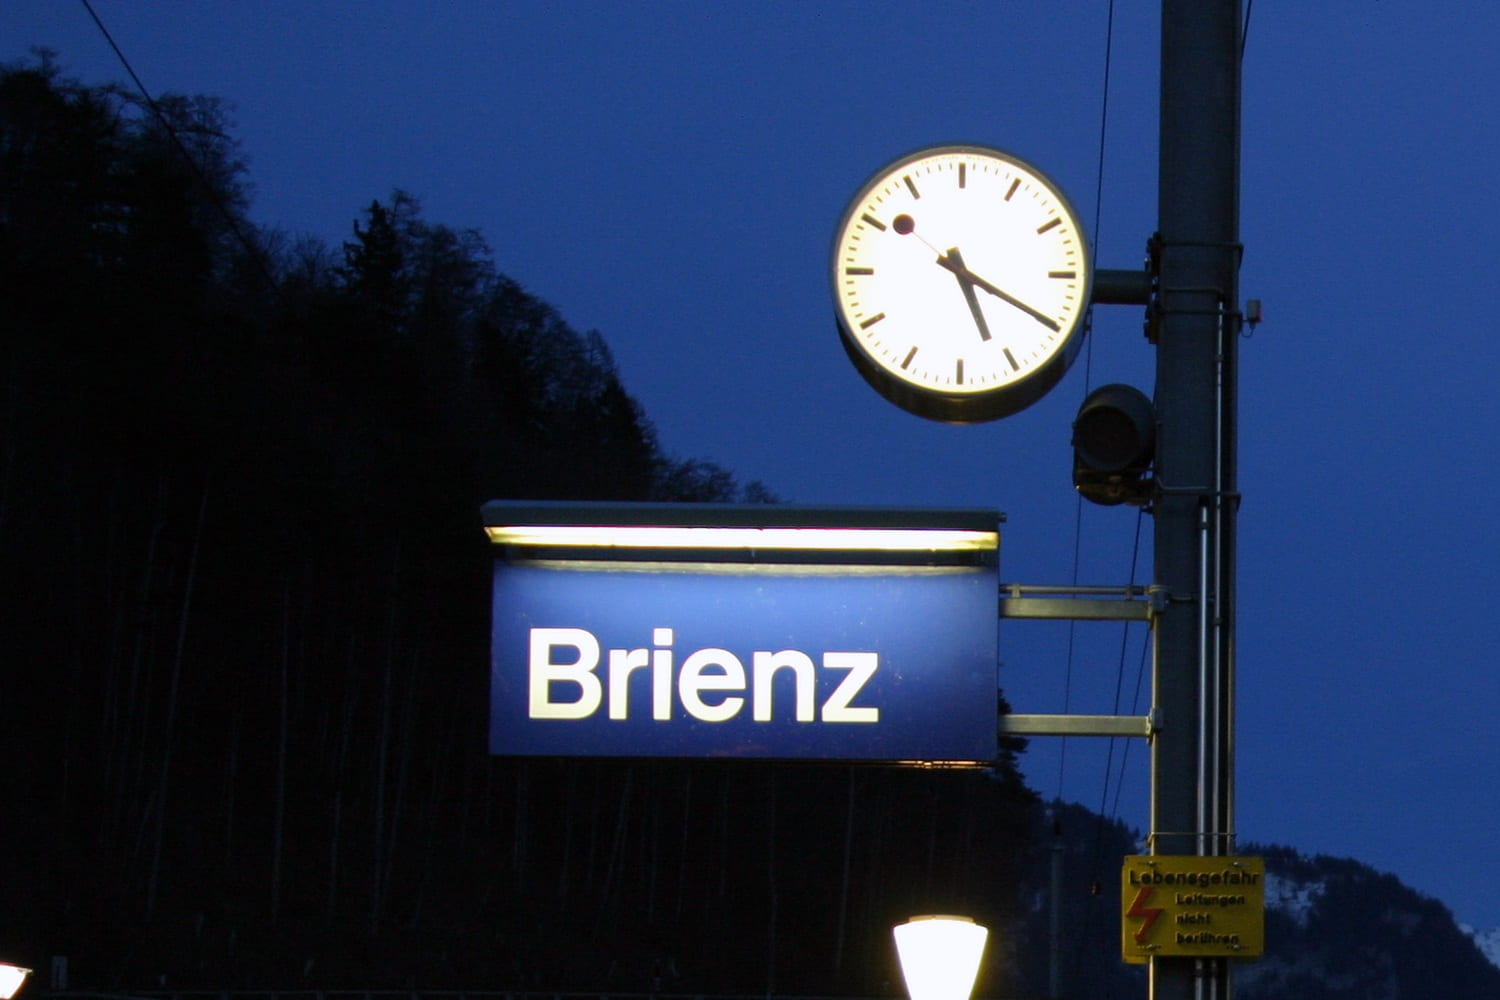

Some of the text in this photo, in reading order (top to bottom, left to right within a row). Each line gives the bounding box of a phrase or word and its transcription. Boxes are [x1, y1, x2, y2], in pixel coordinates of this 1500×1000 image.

[529, 628, 879, 723] Brienz
[1129, 870, 1260, 887] Lebensgefahr
[1176, 893, 1245, 907] Leitungen
[1176, 912, 1211, 924] nicht
[1176, 932, 1239, 945] berühren
